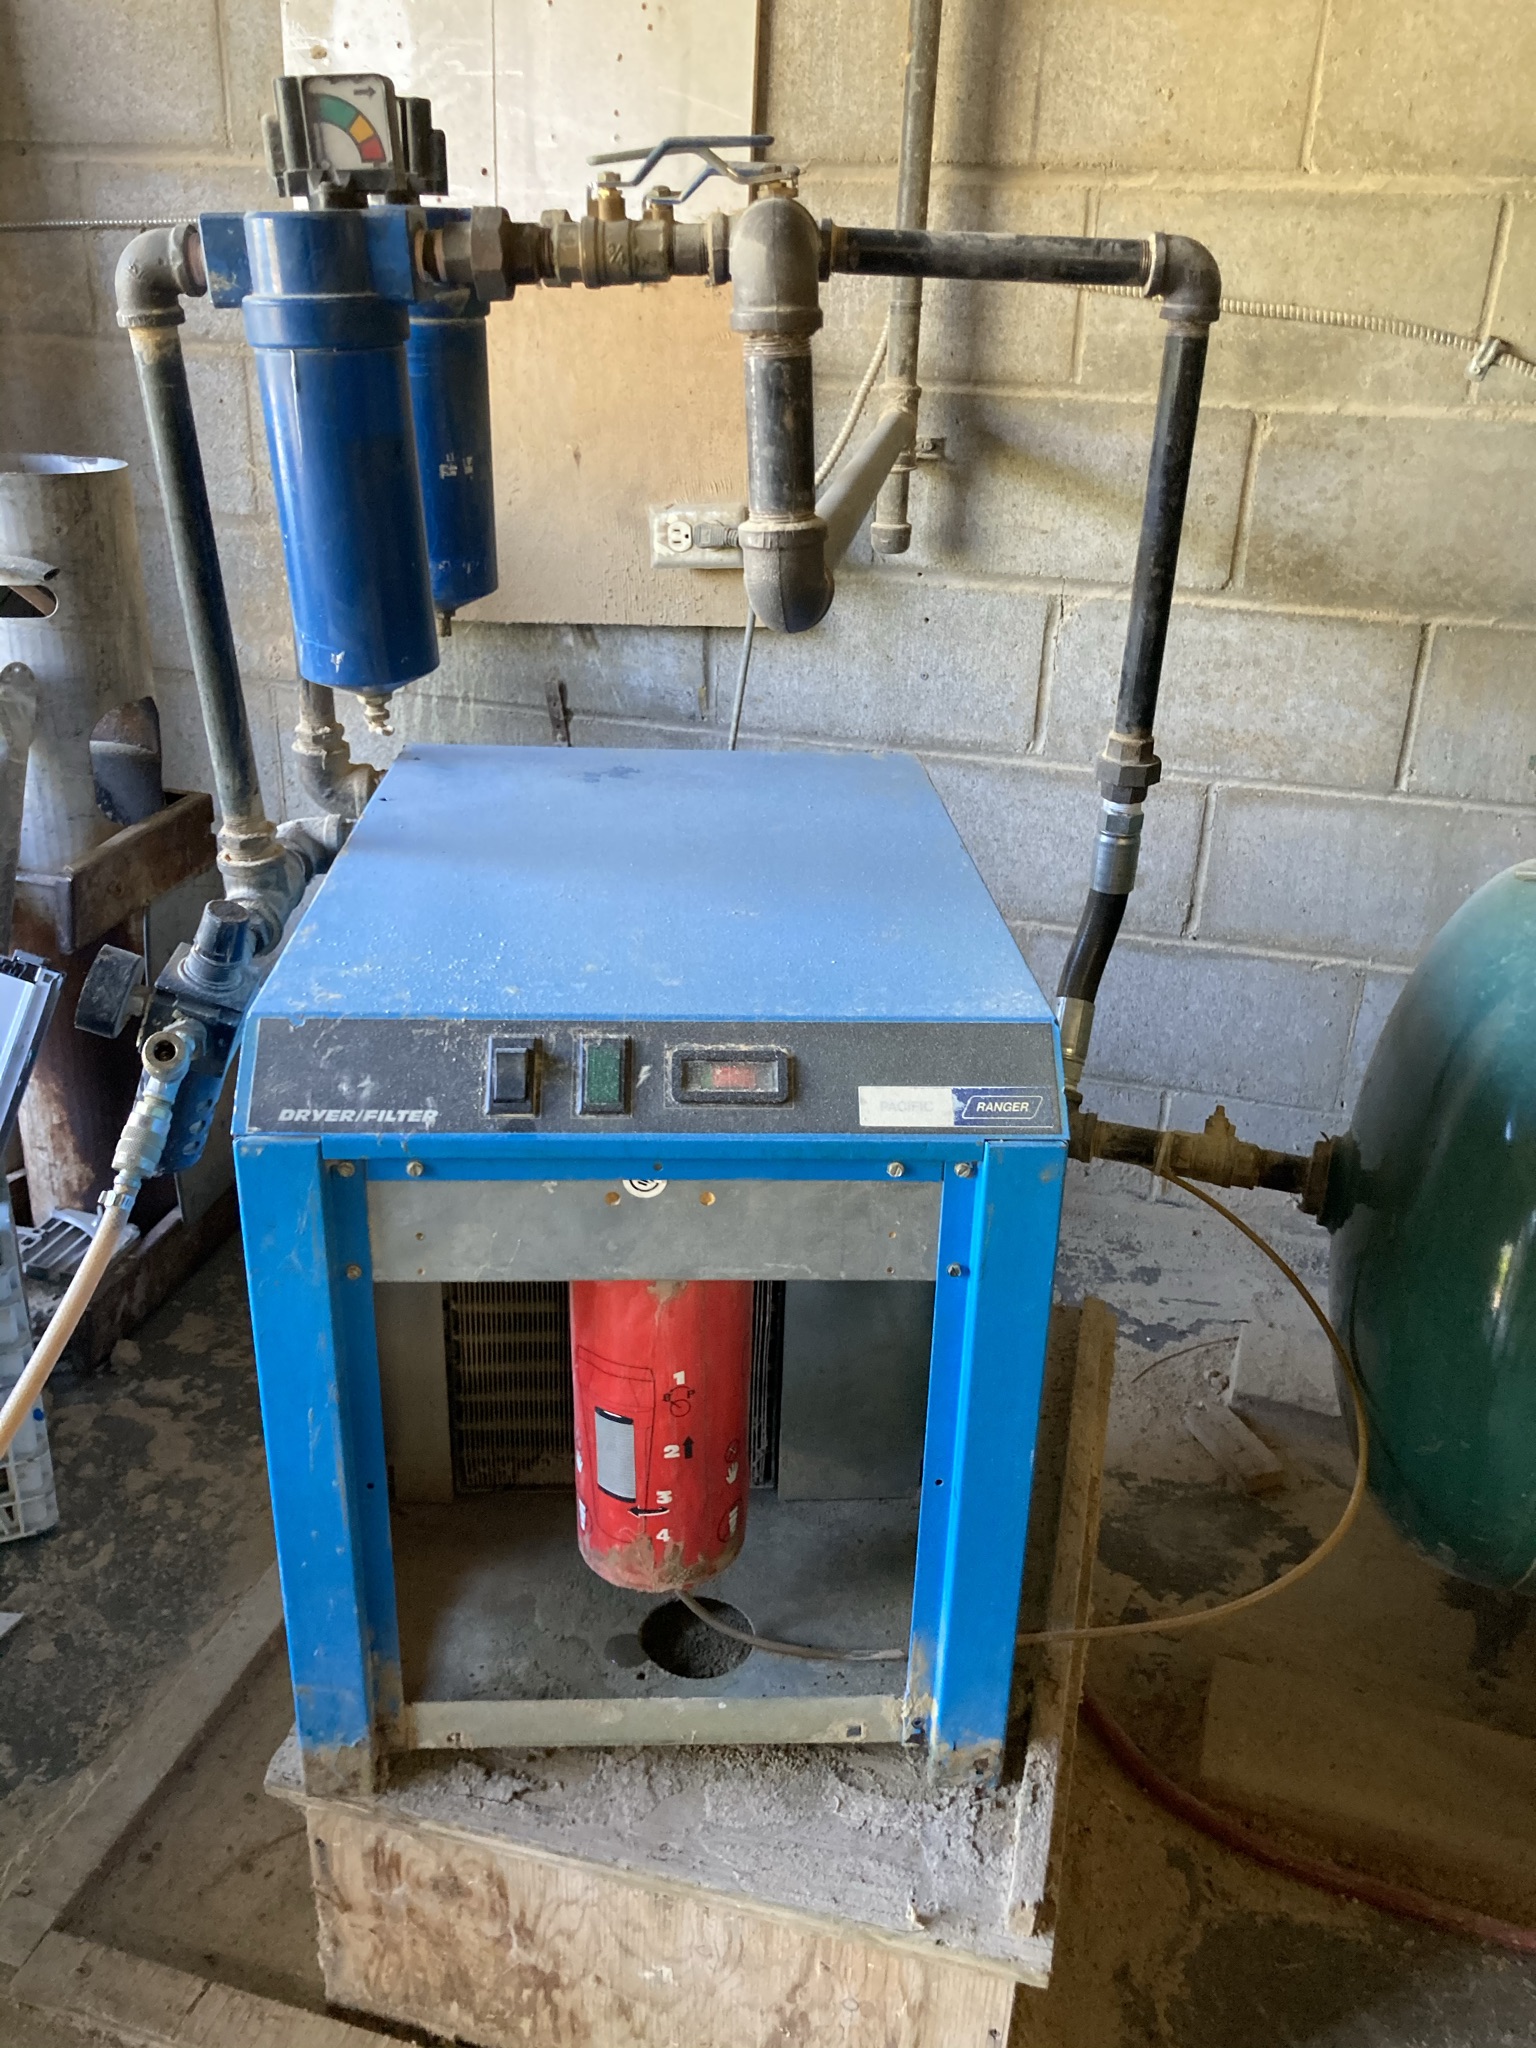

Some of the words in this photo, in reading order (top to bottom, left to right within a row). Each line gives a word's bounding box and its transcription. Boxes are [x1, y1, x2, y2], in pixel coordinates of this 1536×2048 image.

[879, 1100, 934, 1113] PACIFIC
[976, 1102, 1030, 1112] RANGER
[277, 1109, 439, 1123] DRYER/FILTER
[673, 1370, 686, 1386] 1
[663, 1444, 680, 1459] 2
[656, 1490, 673, 1504] 3
[656, 1528, 671, 1542] 4
